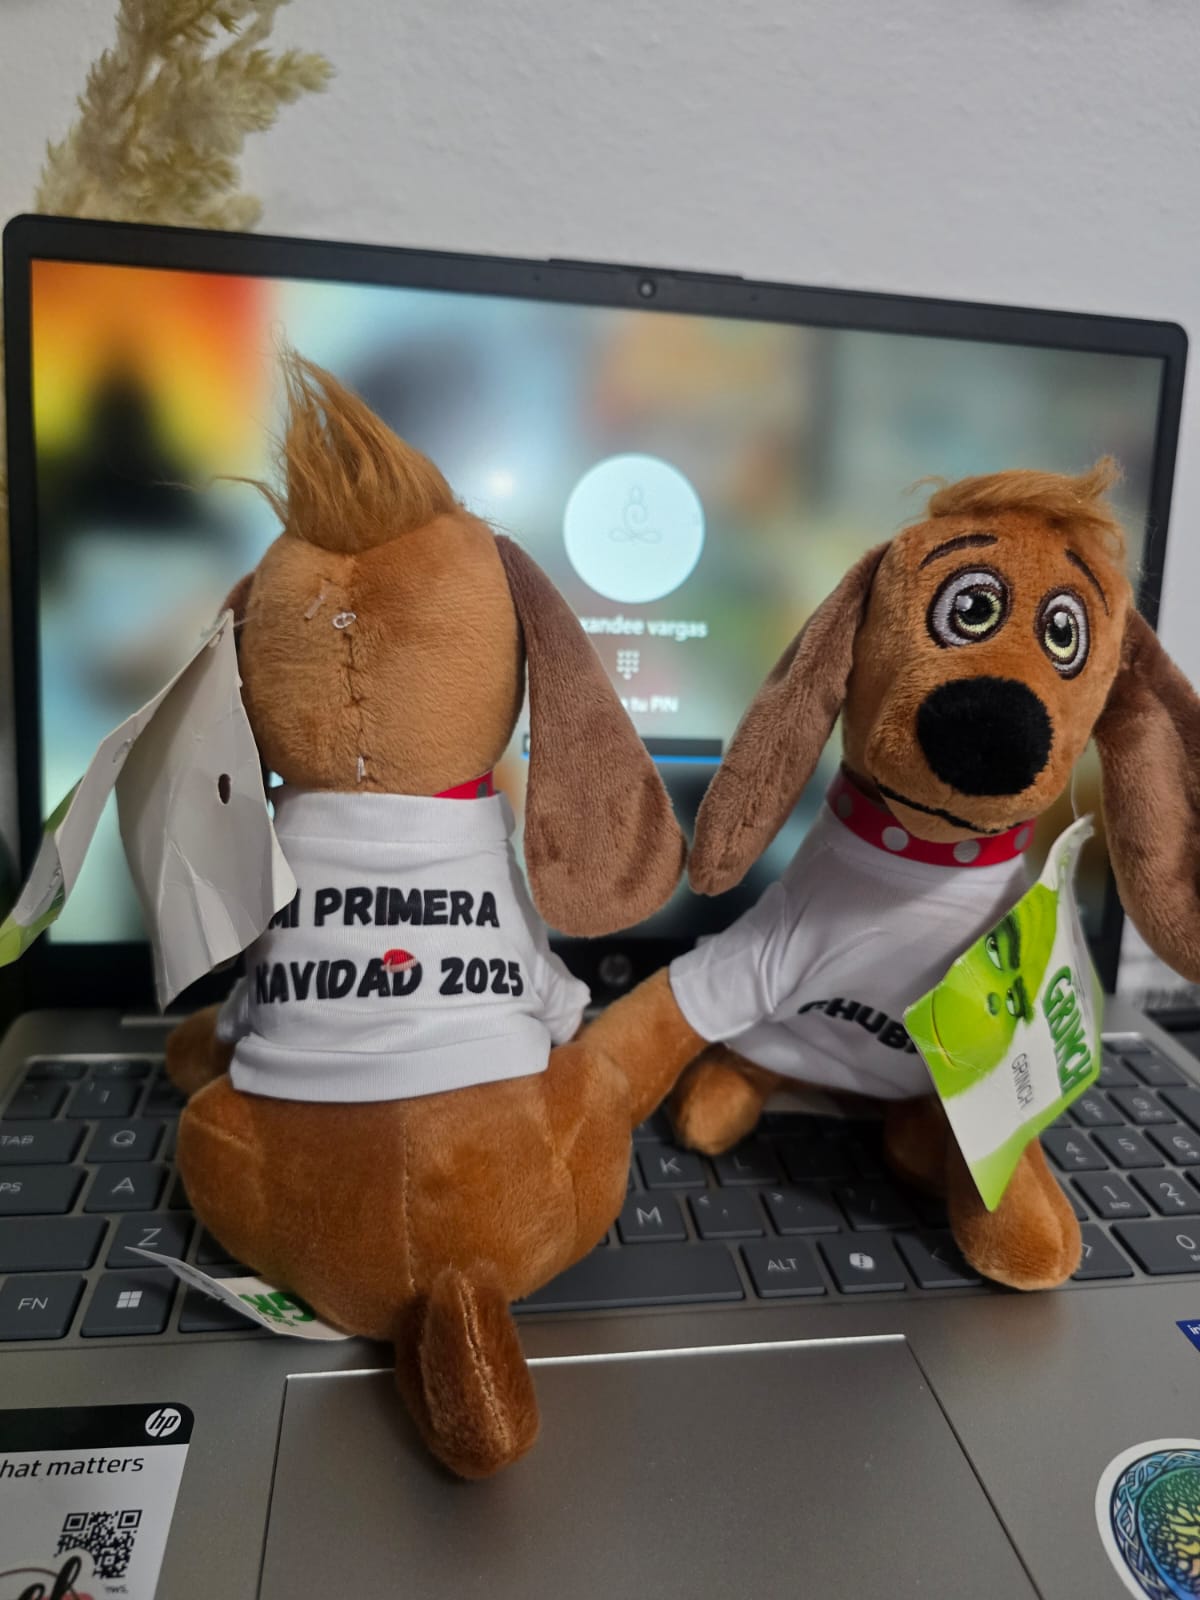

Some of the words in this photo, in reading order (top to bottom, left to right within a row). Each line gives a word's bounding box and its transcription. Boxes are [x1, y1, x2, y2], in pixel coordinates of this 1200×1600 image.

[314, 886, 500, 927] PRIMERA
[256, 957, 423, 1005] NAVIDAD
[439, 957, 524, 996] 2025
[797, 998, 918, 1054] HUB
[1042, 965, 1093, 1098] GRINCH
[1011, 1052, 1034, 1108] GRINCH
[1, 1135, 34, 1145] TAB
[112, 1130, 136, 1146] Q
[660, 1157, 682, 1174] K
[111, 1177, 135, 1194] A
[636, 1206, 662, 1226] M
[138, 1228, 162, 1247] Z
[767, 1258, 798, 1271] ALT
[17, 1297, 48, 1310] FN
[145, 1408, 182, 1437] hp
[46, 1457, 144, 1476] matters
